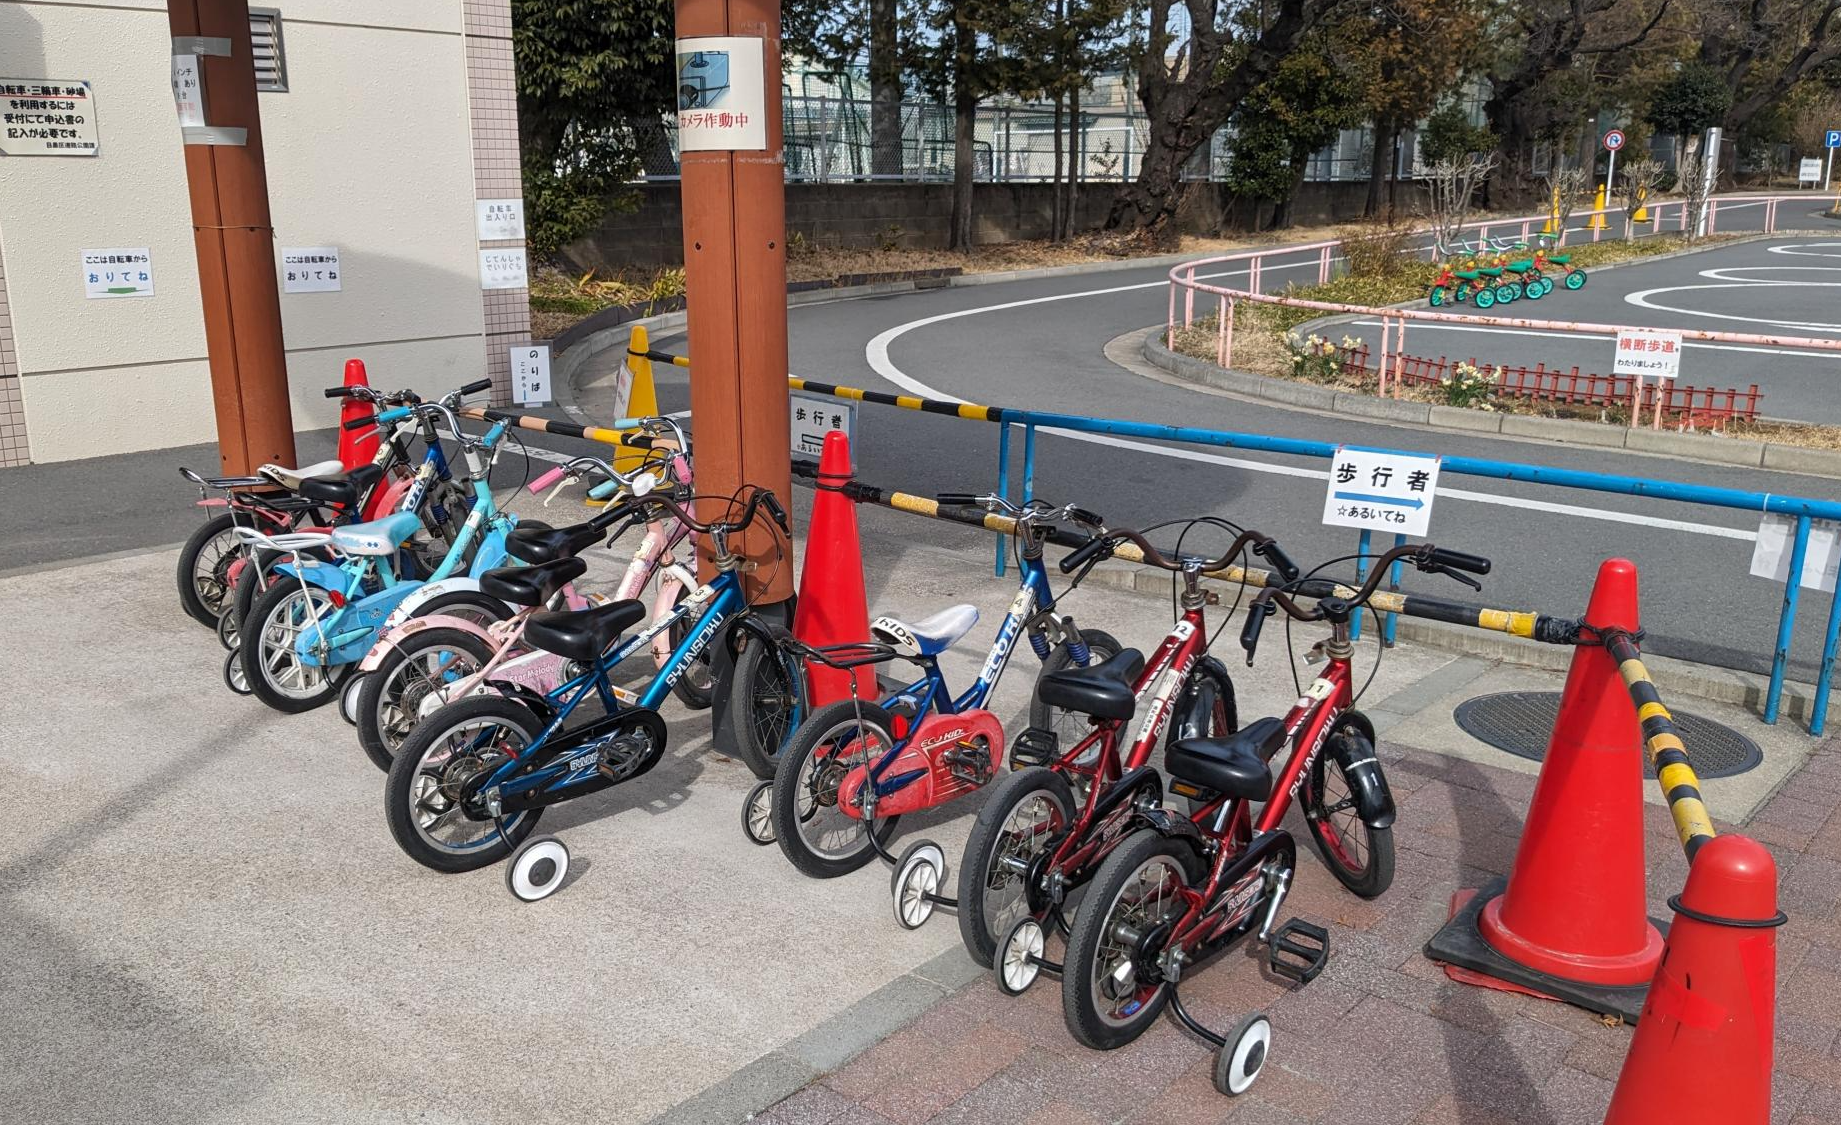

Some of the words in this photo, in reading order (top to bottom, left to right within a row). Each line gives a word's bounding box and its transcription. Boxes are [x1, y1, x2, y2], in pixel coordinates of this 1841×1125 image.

[10, 100, 75, 111] を利用するには
[4, 113, 84, 125] 受付にて申込書の
[1829, 132, 1839, 145] P
[86, 255, 148, 264] ここは自転車から
[286, 255, 338, 264] ここは自転車から
[89, 271, 148, 283] おりてね
[287, 270, 337, 281] おりてね
[1619, 338, 1676, 353] 横断歩道
[529, 350, 541, 392] のりば
[796, 407, 842, 429] 歩行者
[1336, 463, 1430, 492] 歩行者
[1014, 598, 1025, 608] 4
[1173, 624, 1188, 636] 12
[985, 637, 1009, 684] ECO
[1307, 683, 1325, 693] 11
[1178, 722, 1197, 741] 12
[1361, 772, 1379, 791] 11
